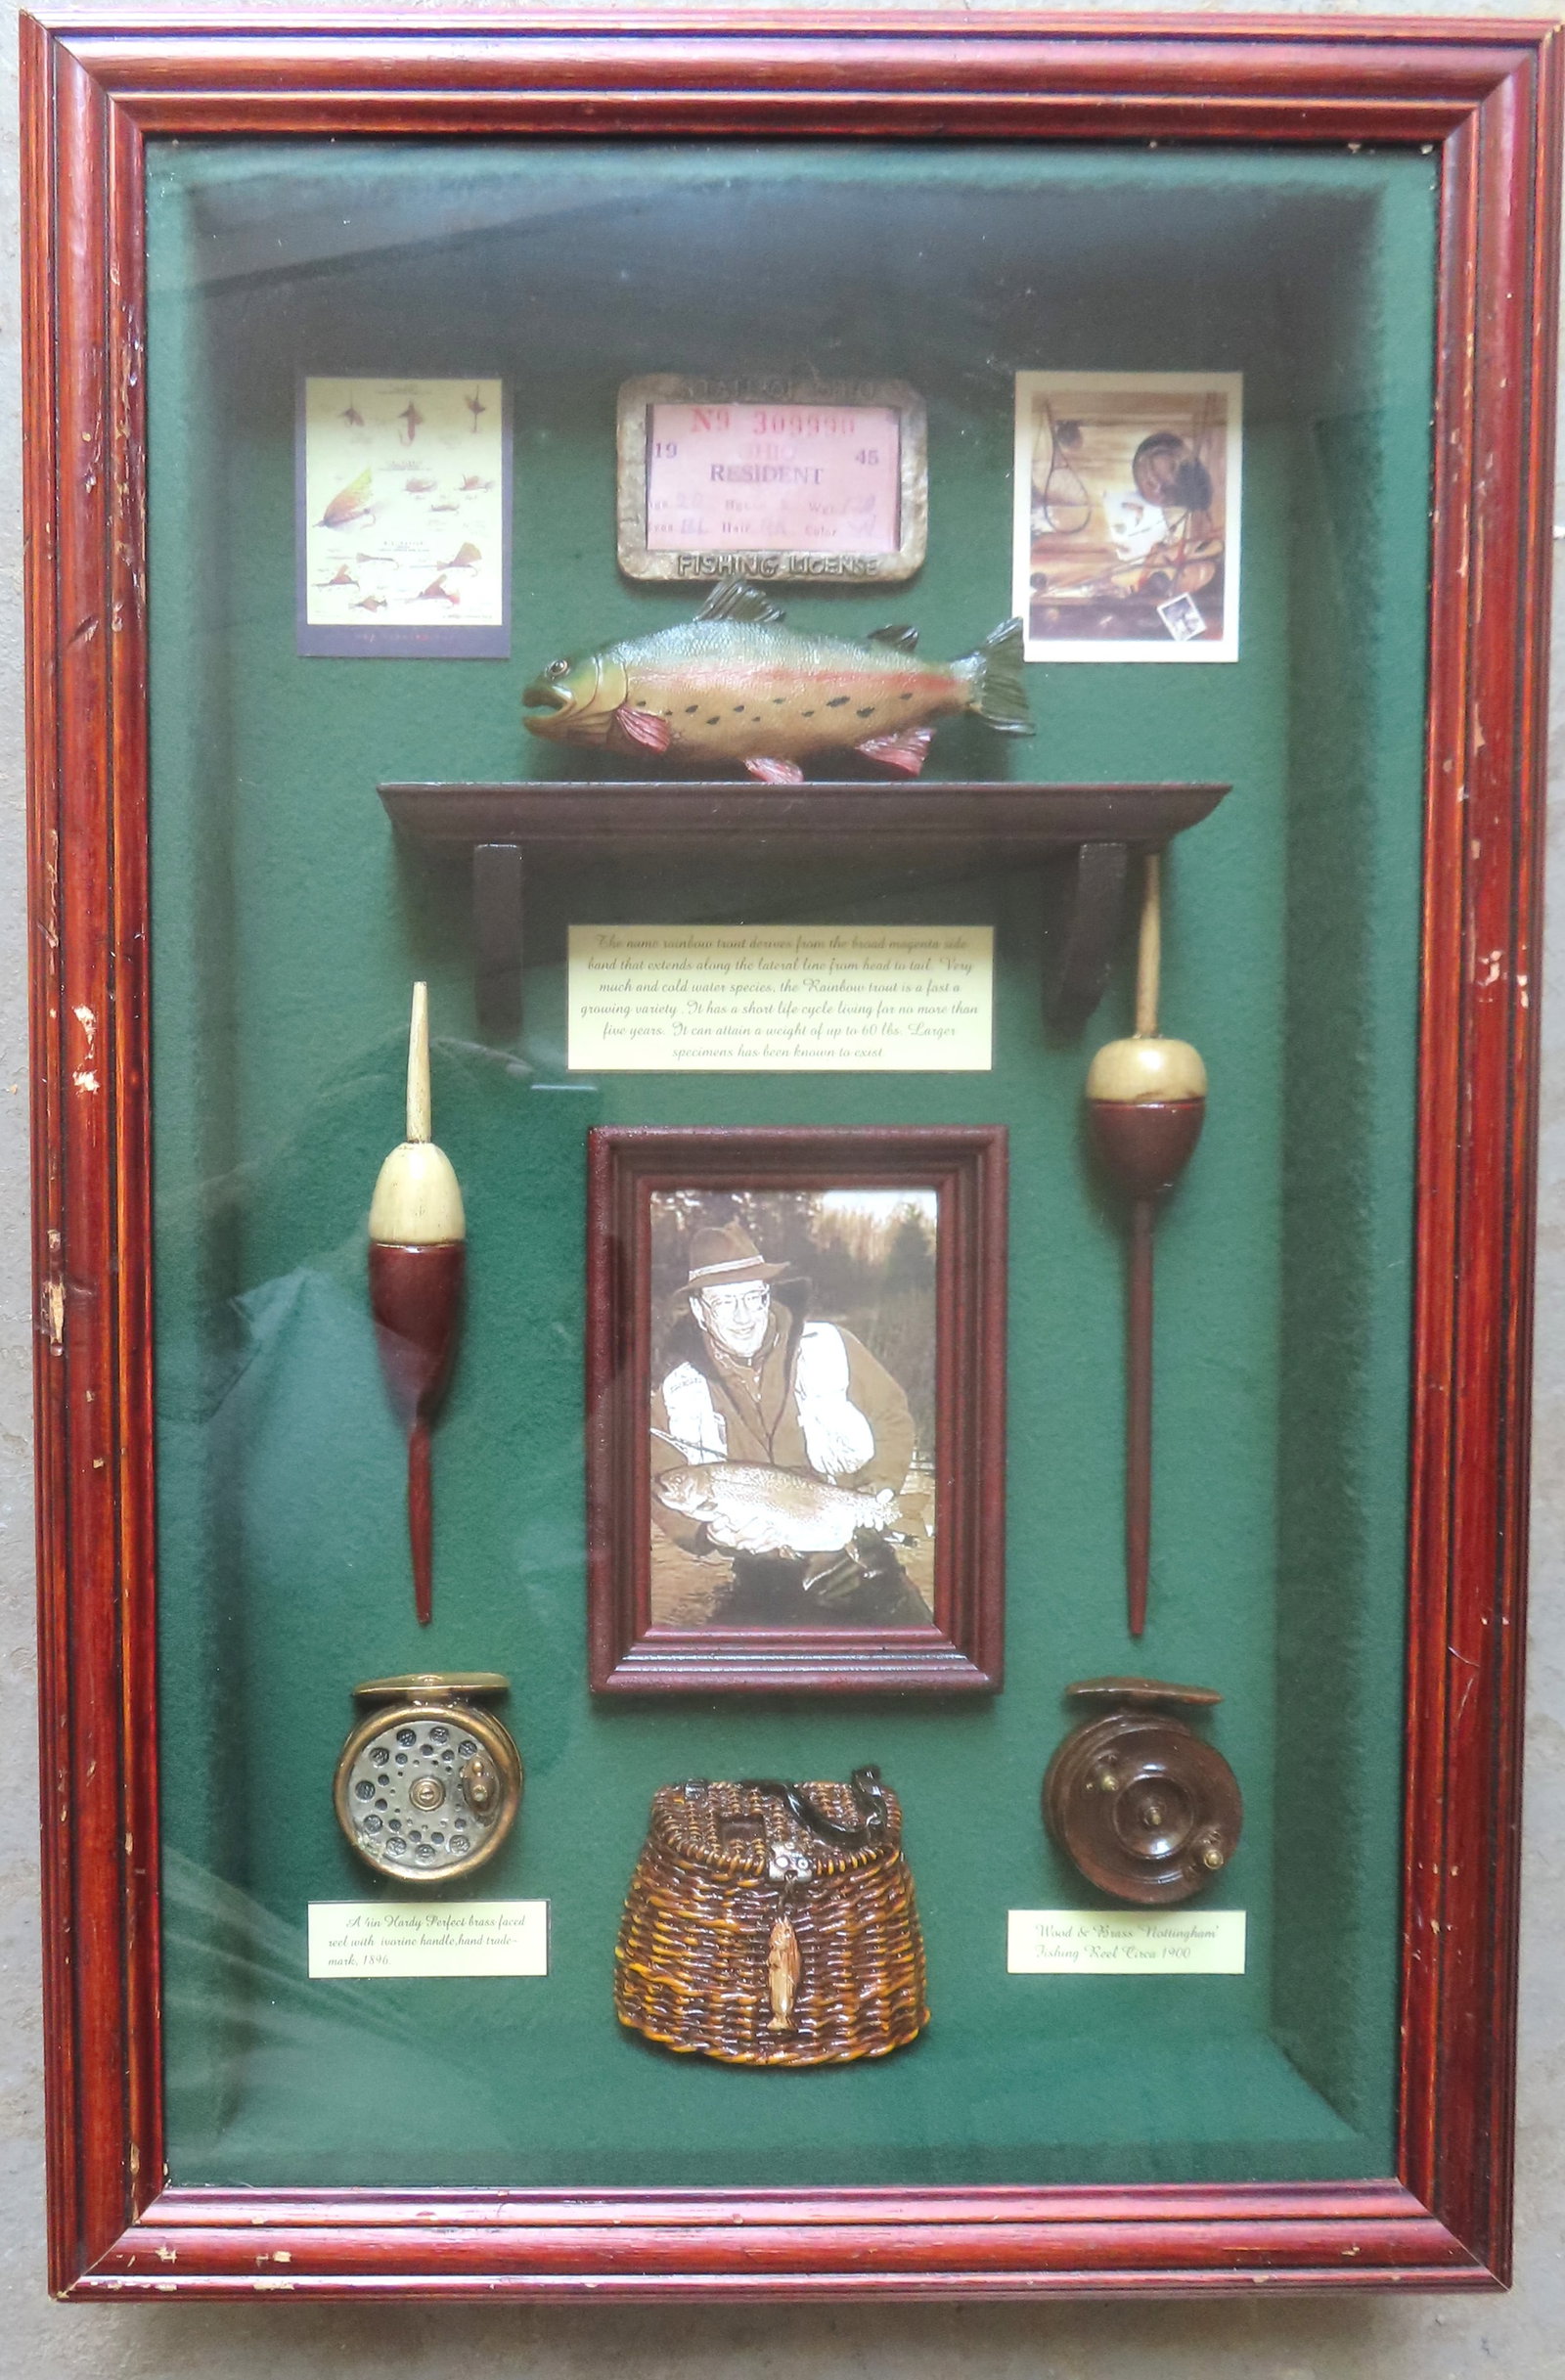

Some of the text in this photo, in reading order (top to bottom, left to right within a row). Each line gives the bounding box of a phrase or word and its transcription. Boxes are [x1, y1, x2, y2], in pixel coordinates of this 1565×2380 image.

[653, 442, 678, 459] 19
[854, 448, 879, 466] 45
[710, 464, 825, 485] RESIDENT
[678, 554, 878, 577] FISHING LICENSE
[596, 934, 622, 948] The
[663, 935, 712, 948] rainbow
[717, 937, 746, 948] trout
[749, 935, 791, 948] derives
[795, 935, 826, 954] from
[829, 935, 848, 948] the
[889, 939, 940, 954] magenta
[588, 958, 616, 970] band
[620, 958, 644, 970] that
[648, 958, 693, 970] extends
[696, 958, 730, 974] along
[736, 958, 753, 970] the
[758, 957, 798, 970] lateral
[802, 958, 827, 970] line
[829, 958, 859, 975] from
[863, 957, 892, 970] head
[894, 962, 907, 970] to
[939, 956, 973, 976] Very
[600, 978, 632, 992] much
[636, 980, 658, 992] and
[662, 979, 689, 992] cold
[692, 983, 725, 992] water
[781, 979, 798, 992] the
[803, 978, 865, 992] Rainbow
[869, 982, 898, 992] trout
[902, 982, 912, 992] is
[926, 979, 950, 997] fast
[580, 1006, 631, 1017] growing
[687, 1000, 703, 1014] It
[706, 1001, 727, 1014] has
[741, 1000, 773, 1013] short
[778, 1000, 798, 1018] life
[802, 1000, 833, 1018] cycle
[837, 1000, 872, 1018] living
[876, 1000, 895, 1018] for
[899, 1006, 914, 1014] no
[917, 1006, 948, 1014] more
[952, 1000, 978, 1014] than
[603, 1022, 626, 1040] five
[672, 1021, 688, 1036] It
[716, 1024, 750, 1036] attain
[766, 1021, 807, 1040] weight
[810, 1021, 824, 1040] of
[827, 1028, 842, 1039] up
[845, 1026, 858, 1035] to
[862, 1023, 877, 1036] 60
[908, 1021, 957, 1040] Larger
[672, 1047, 734, 1061] specimens
[738, 1044, 759, 1057] has
[763, 1043, 790, 1056] been
[794, 1043, 835, 1056] known
[839, 1048, 851, 1056] to
[345, 1915, 362, 1928] A
[383, 1914, 423, 1931] Hardy
[425, 1914, 467, 1930] Perfect
[469, 1914, 496, 1927] brass
[498, 1914, 526, 1929] faced
[1035, 1924, 1073, 1938] Wood
[1093, 1924, 1134, 1938] Brass
[329, 1935, 348, 1948] reel
[351, 1934, 375, 1946] with
[380, 1937, 418, 1947] ivorine
[1035, 1944, 1191, 1962] Fishing Reel Circa 1900
